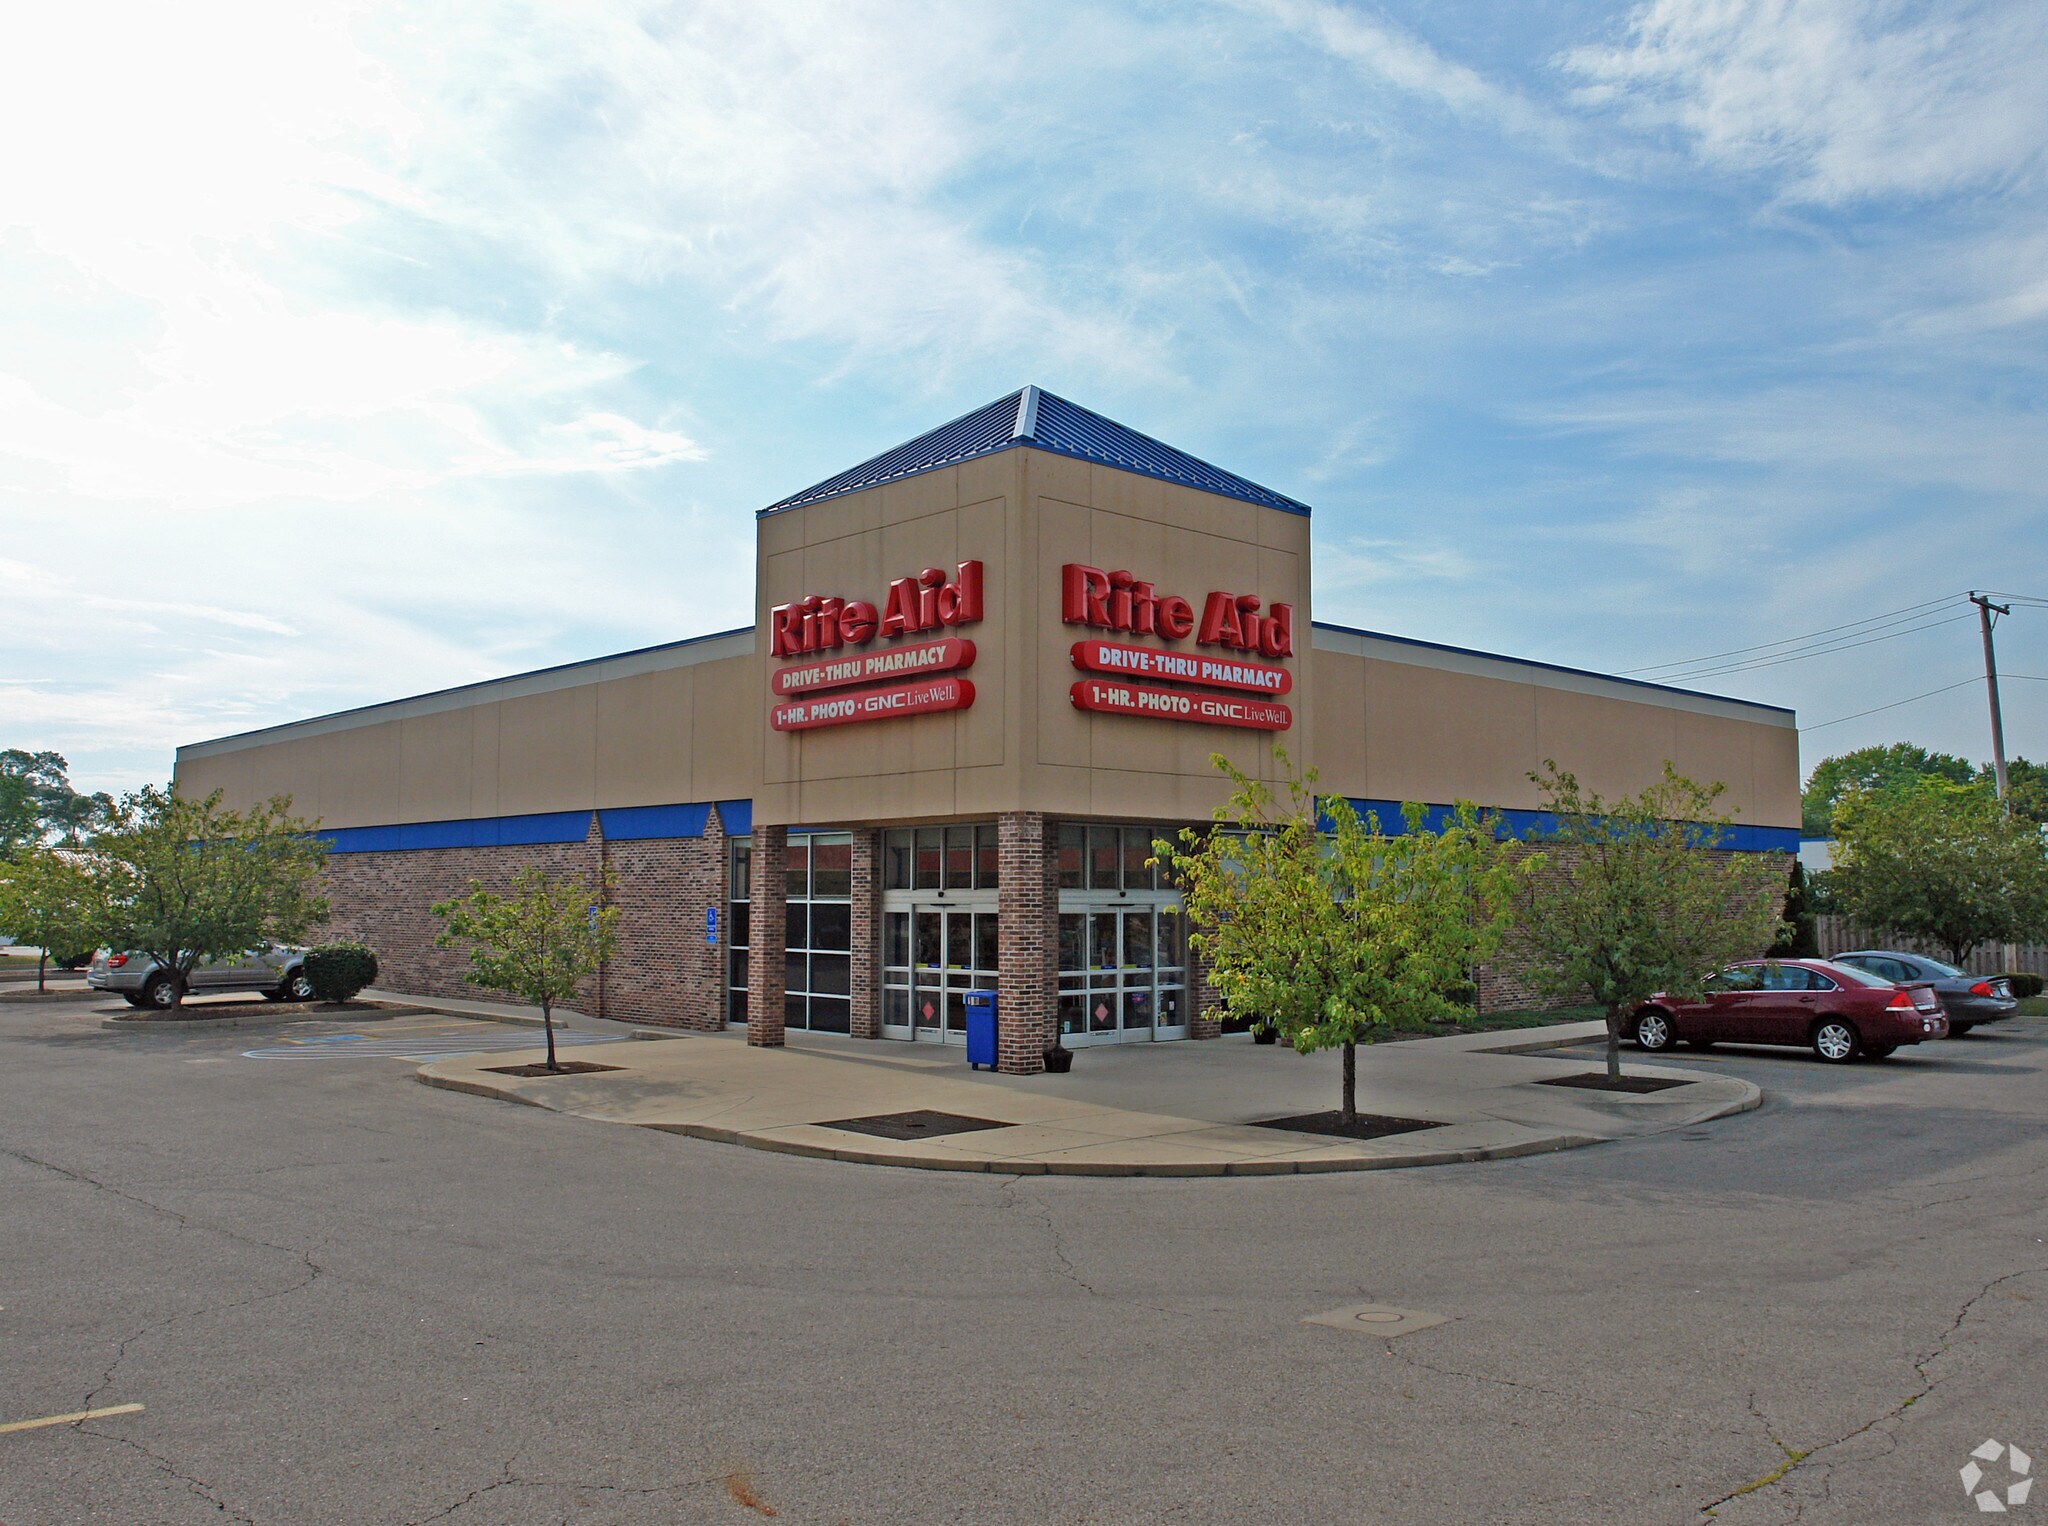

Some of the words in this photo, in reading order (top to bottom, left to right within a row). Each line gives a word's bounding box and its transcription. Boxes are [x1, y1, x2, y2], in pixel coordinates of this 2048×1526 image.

[770, 595, 878, 657] Rite
[880, 560, 983, 637] Aid
[1062, 564, 1194, 640] Rite
[1196, 591, 1294, 658] Aid
[782, 664, 861, 689] DRIVE-THRU
[865, 645, 947, 675] PHARMACY
[1099, 647, 1197, 677] DRIVE-THRU
[1201, 662, 1283, 689] PHARMACY
[776, 707, 809, 726] 1-HR.
[811, 699, 856, 721] PHOTO
[864, 693, 906, 712] GNC
[1092, 686, 1135, 707] 1-HR.
[1138, 692, 1191, 714] PHOTO
[1201, 701, 1243, 720] GNC
